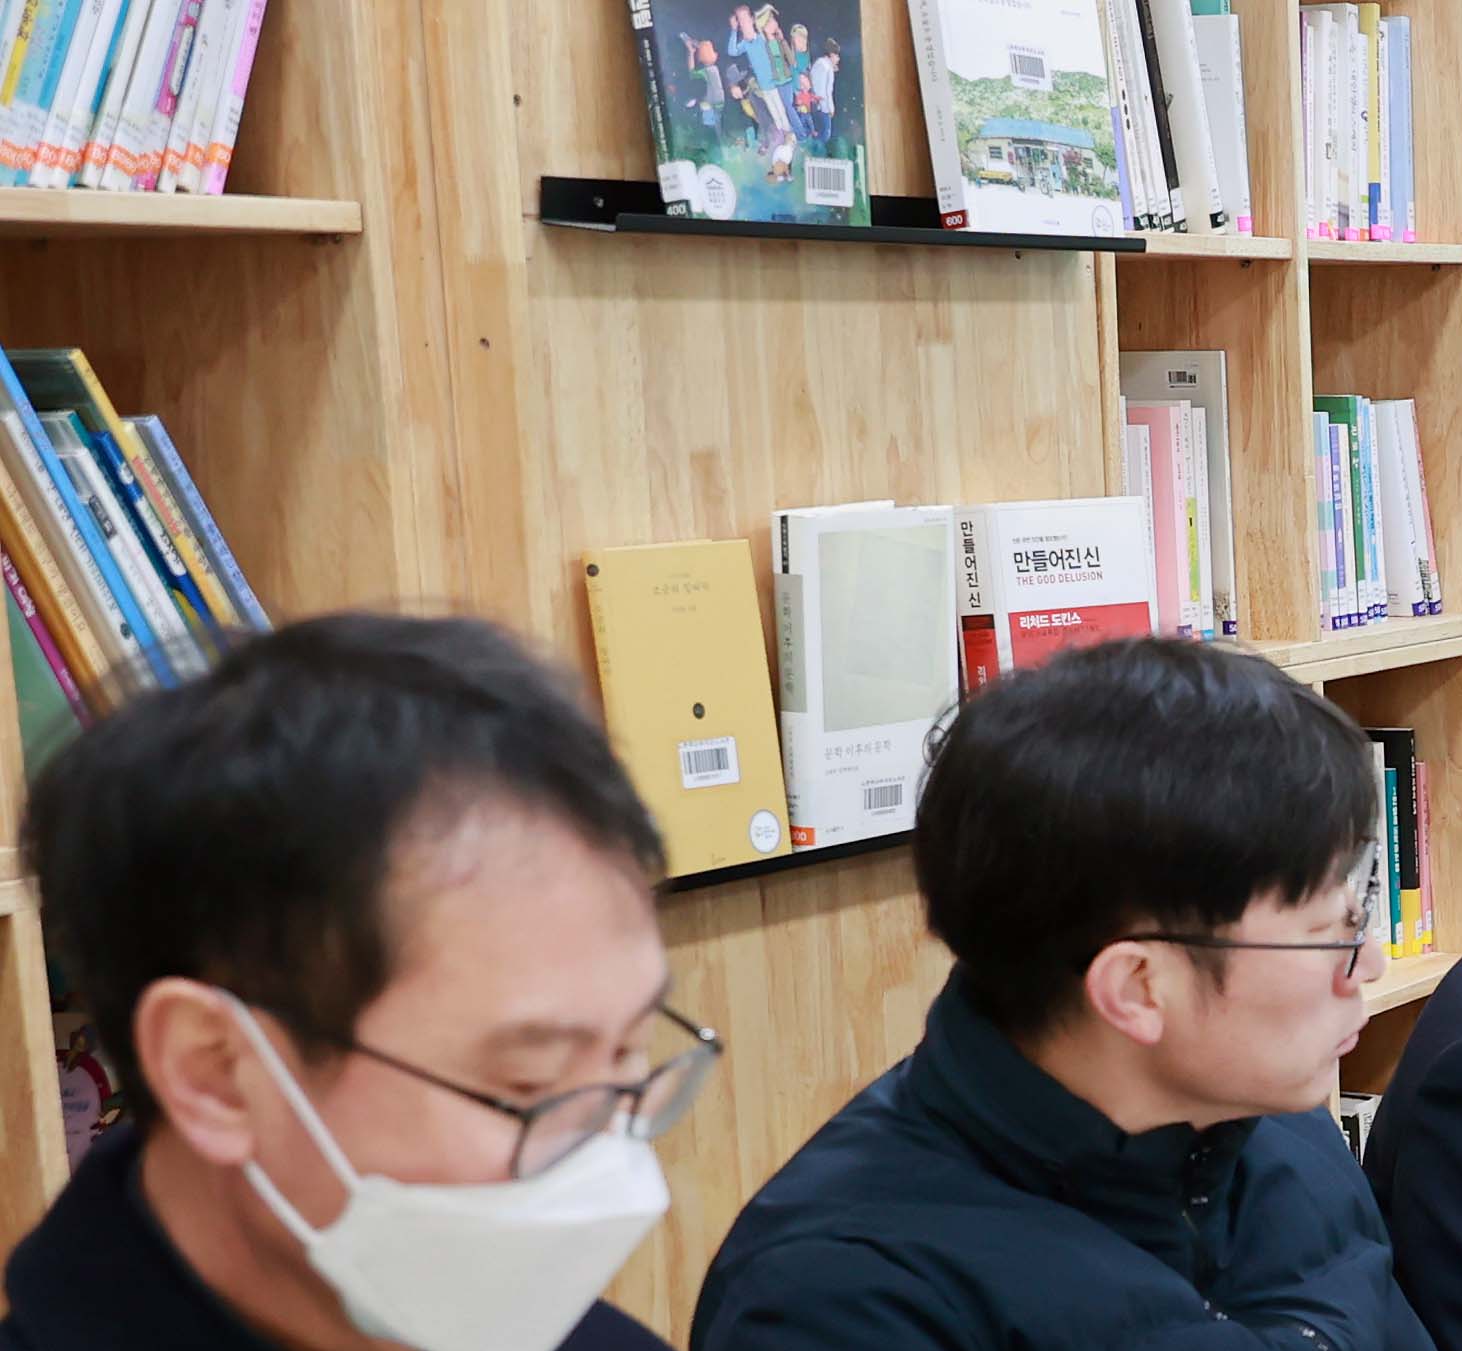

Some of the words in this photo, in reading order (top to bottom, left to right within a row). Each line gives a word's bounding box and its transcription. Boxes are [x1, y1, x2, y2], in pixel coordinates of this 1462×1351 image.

[667, 205, 686, 216] 400
[945, 214, 963, 226] 600
[960, 520, 979, 589] 만들어진
[1013, 547, 1081, 573] 만들어진
[1085, 546, 1101, 569] 신
[1016, 574, 1035, 587] THE
[1036, 573, 1056, 586] GOD
[1058, 570, 1104, 584] DELUSION
[968, 591, 982, 609] 신
[1019, 614, 1050, 630] 리처드
[1051, 611, 1083, 627] 도킨스
